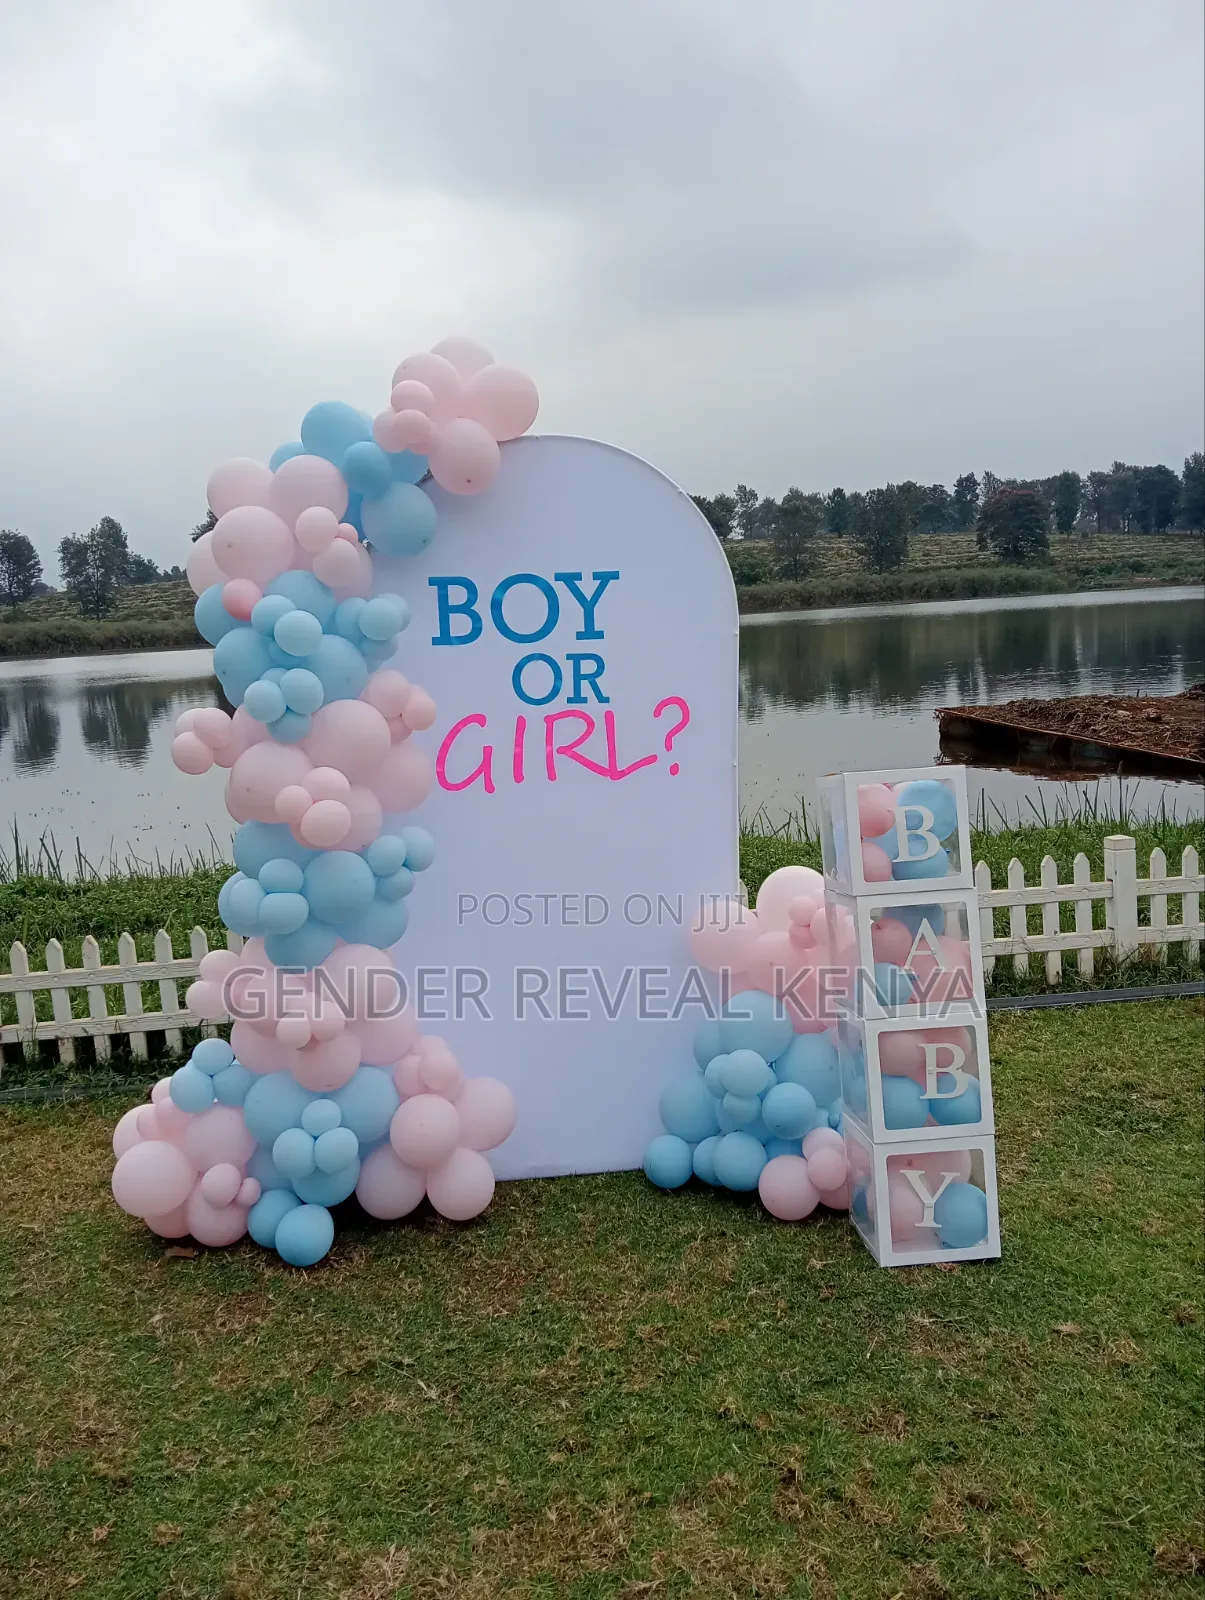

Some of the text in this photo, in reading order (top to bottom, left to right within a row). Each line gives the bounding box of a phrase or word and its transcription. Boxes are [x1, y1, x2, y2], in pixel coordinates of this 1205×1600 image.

[428, 570, 620, 646] BOY
[511, 652, 610, 706] OR
[435, 696, 690, 794] GIRL?
